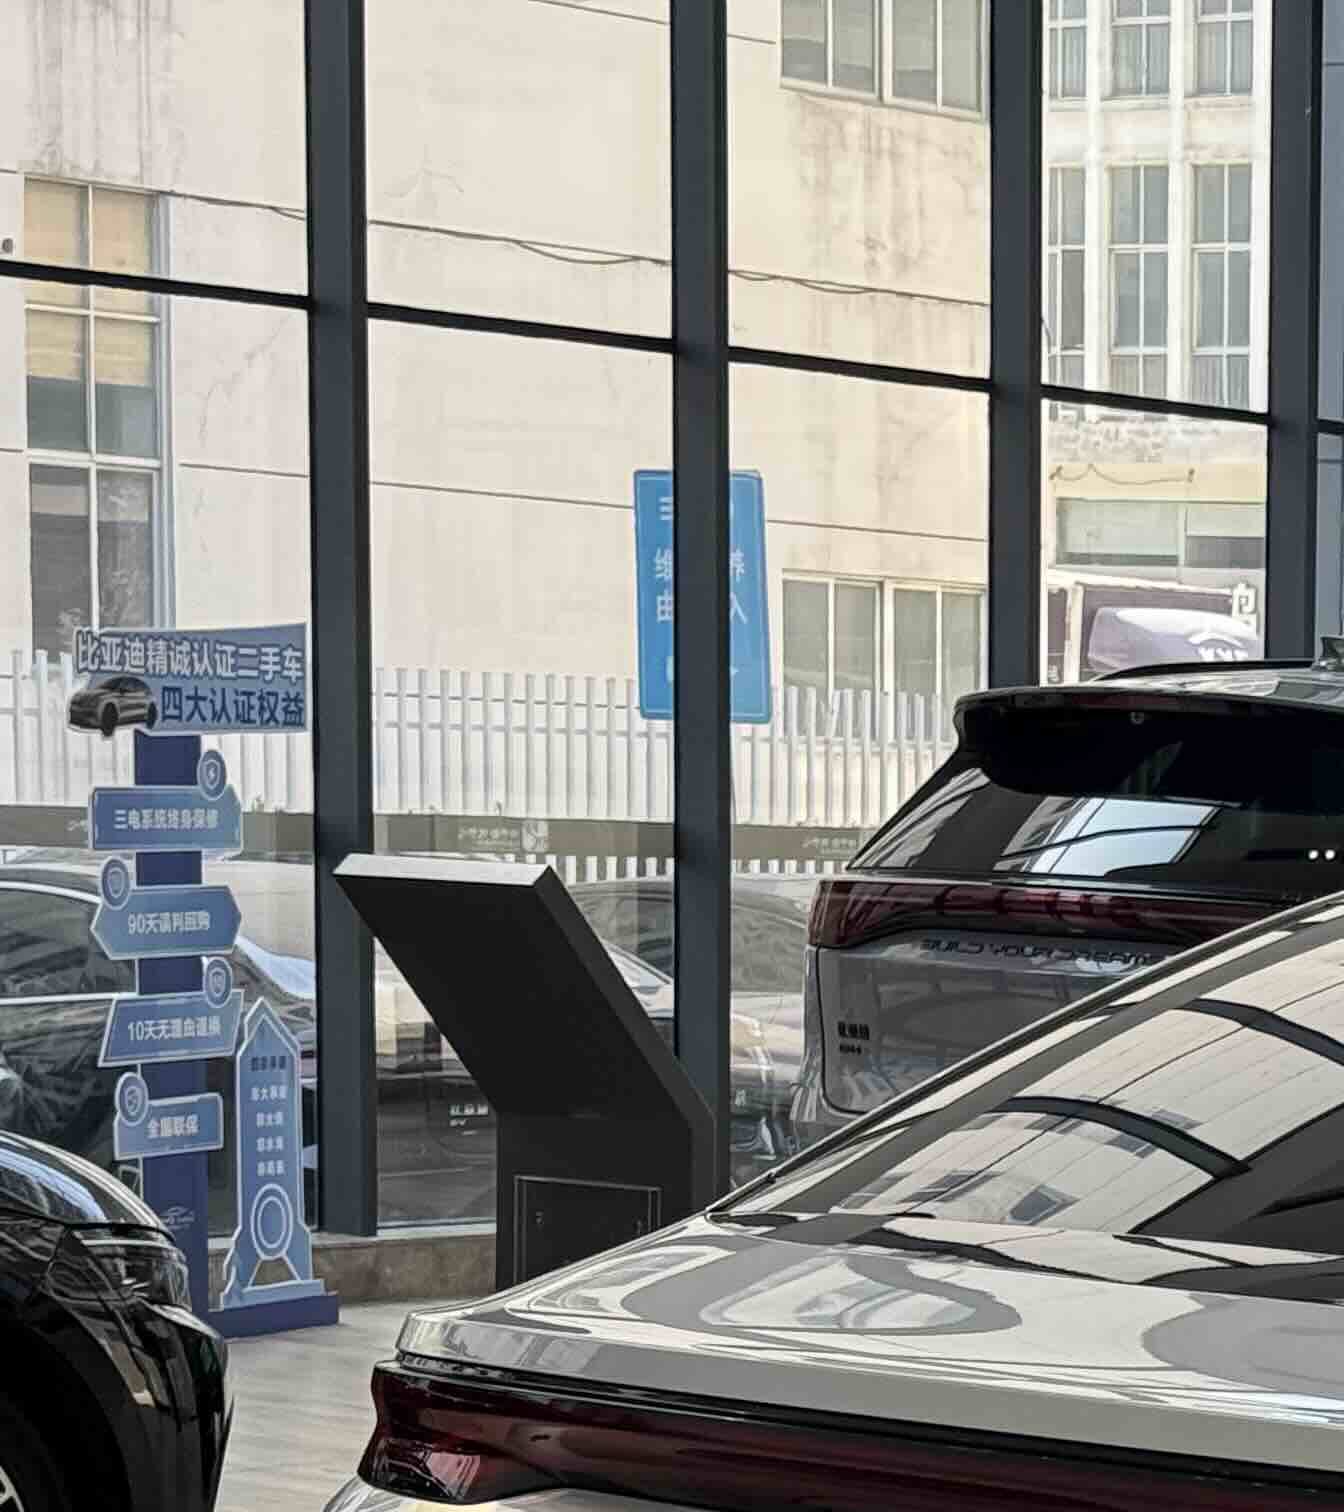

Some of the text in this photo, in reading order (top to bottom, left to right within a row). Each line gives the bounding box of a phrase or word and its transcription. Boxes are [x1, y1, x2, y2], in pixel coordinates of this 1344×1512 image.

[78, 631, 303, 683] 比亚迪精诚认证二手车
[161, 686, 305, 727] 四大认证权益
